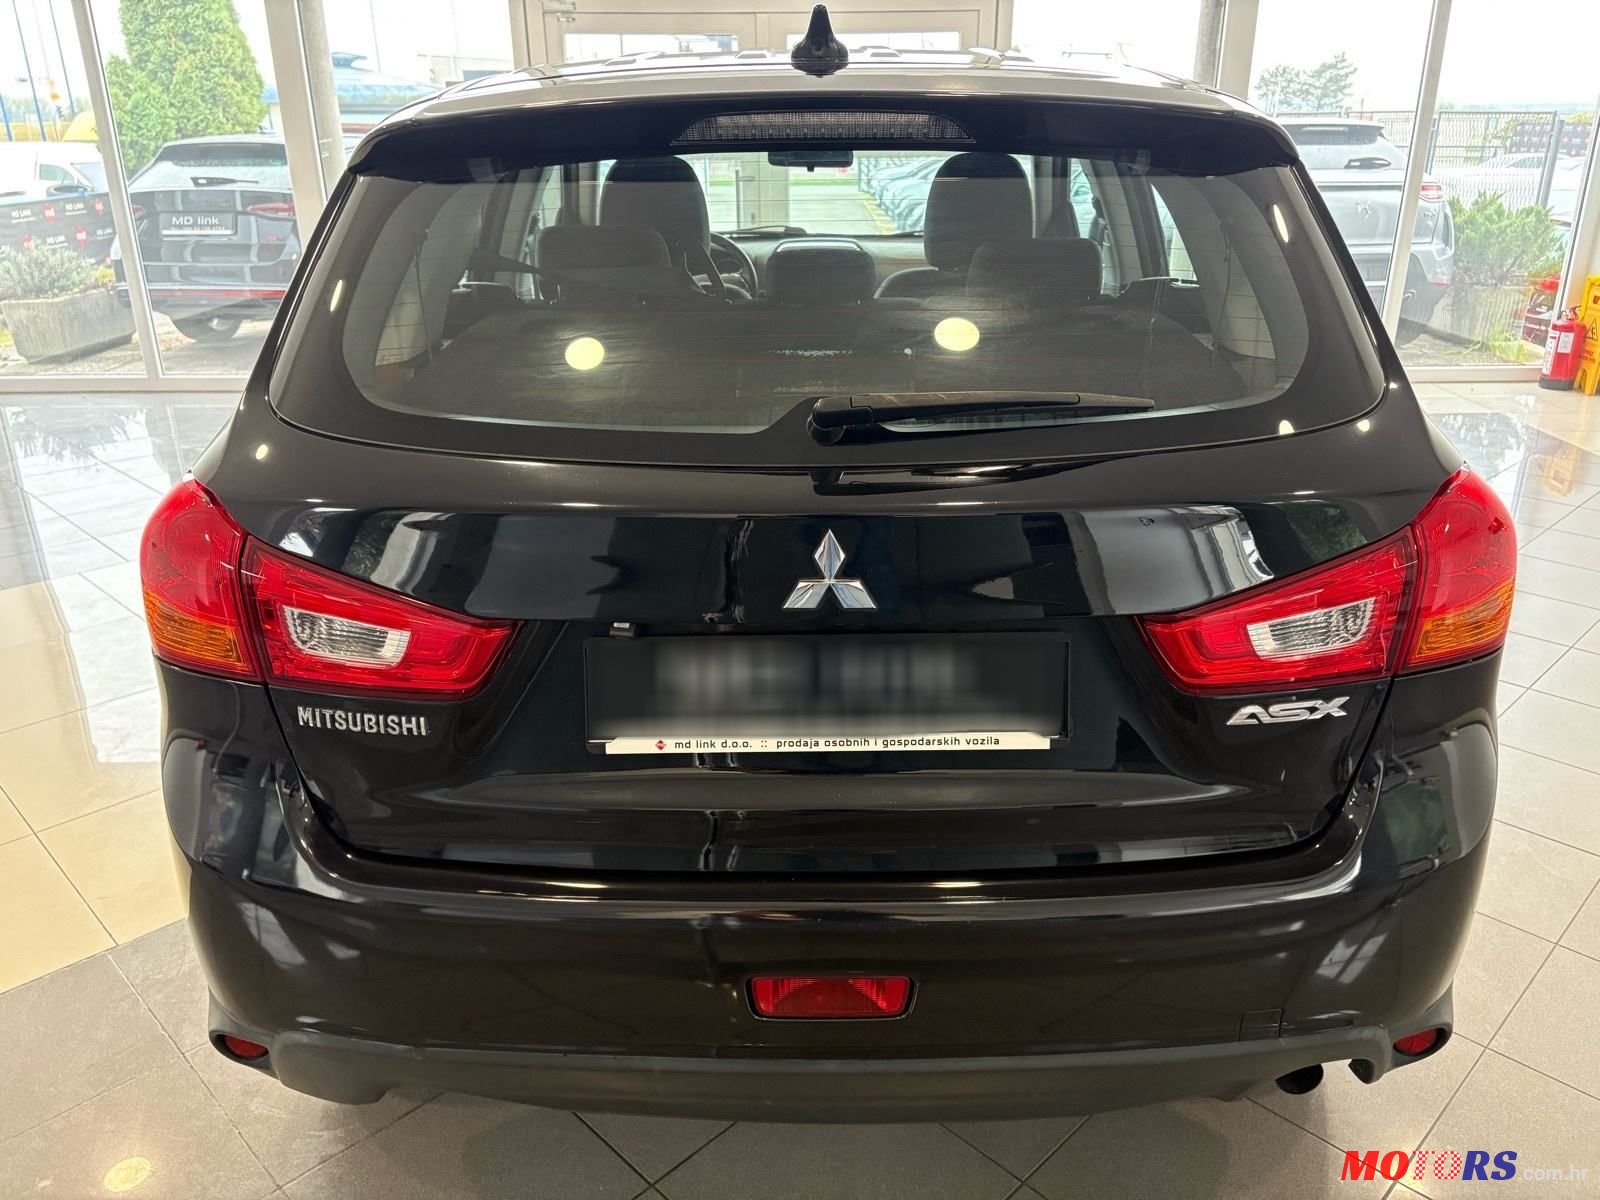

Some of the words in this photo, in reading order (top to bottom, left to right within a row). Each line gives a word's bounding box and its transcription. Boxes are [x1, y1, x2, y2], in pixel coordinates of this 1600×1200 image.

[171, 215, 193, 225] MD
[197, 215, 220, 225] link
[297, 706, 427, 736] MITSUBISHI
[1226, 696, 1350, 726] ASX
[674, 739, 691, 749] md
[696, 739, 716, 749] link
[721, 738, 752, 748] d.o.o.
[776, 738, 820, 750] prodaja
[824, 737, 870, 748] osobnih
[882, 735, 960, 748] gospodarskih
[965, 736, 1000, 746] vozila
